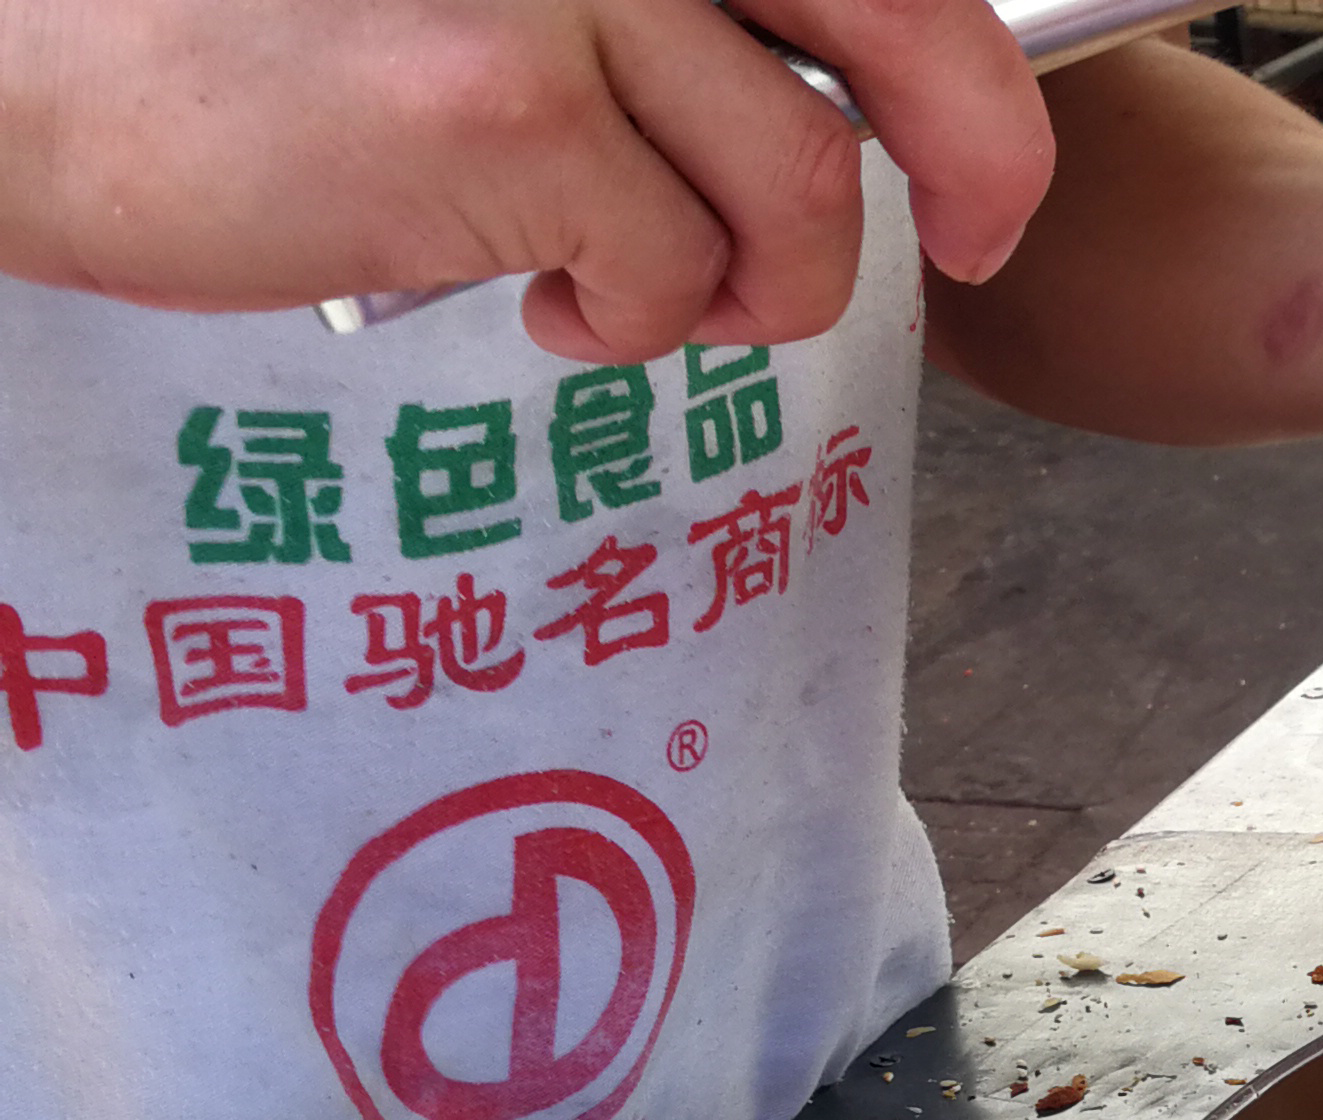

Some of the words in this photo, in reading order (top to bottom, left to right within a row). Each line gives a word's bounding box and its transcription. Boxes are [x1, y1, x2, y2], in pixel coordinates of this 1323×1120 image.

[0, 426, 872, 752] 中国驰名商标
[178, 346, 782, 564] 绿色食品
